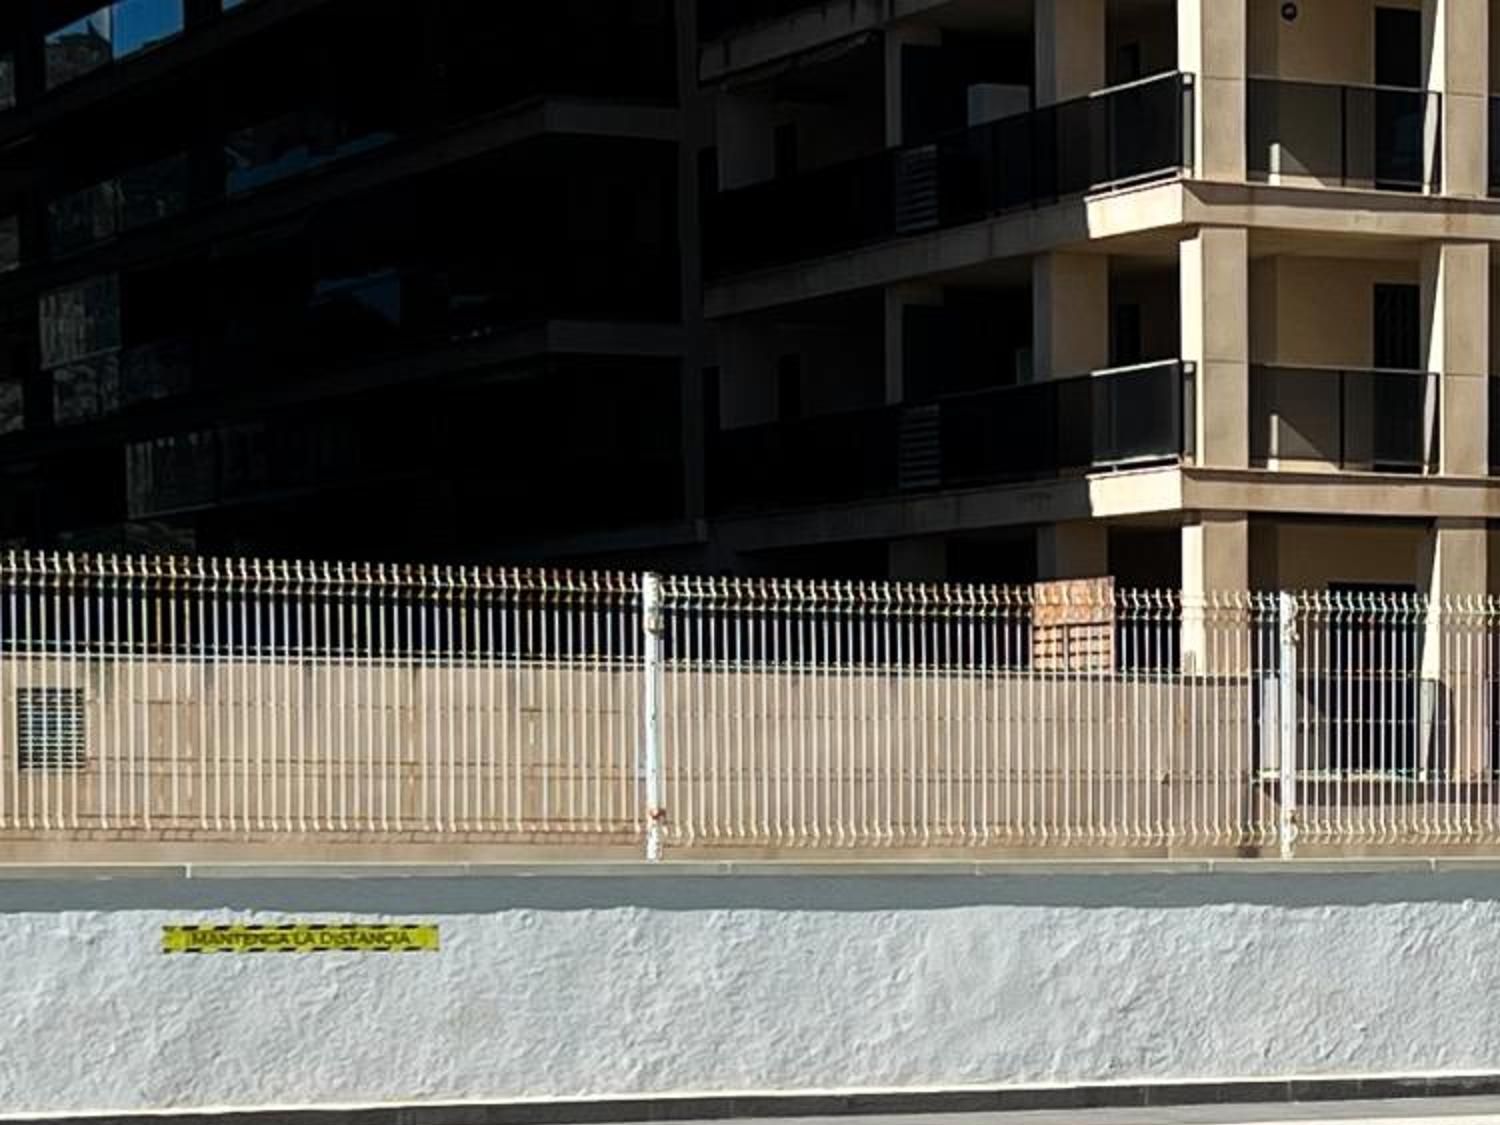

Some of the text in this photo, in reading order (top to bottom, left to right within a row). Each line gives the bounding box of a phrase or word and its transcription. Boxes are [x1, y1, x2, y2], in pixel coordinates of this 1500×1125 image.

[191, 931, 411, 946] MANTENGA LA DISTANCIA
